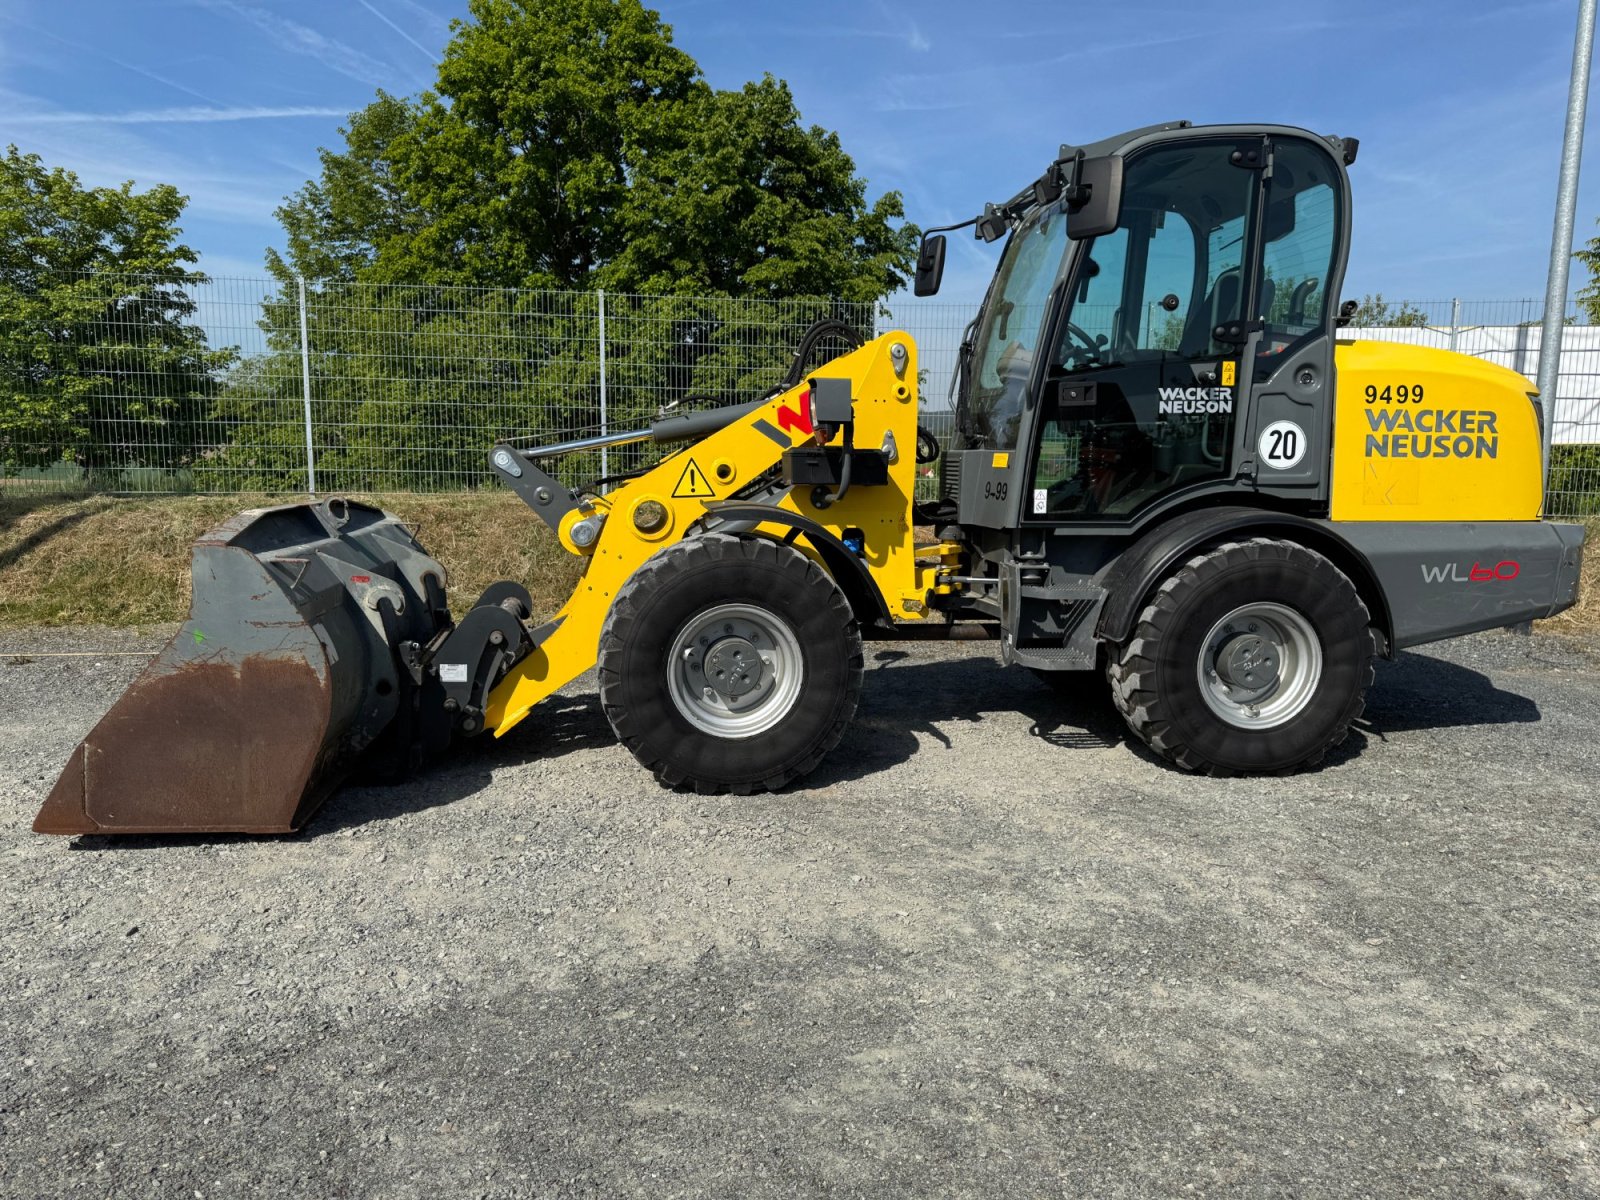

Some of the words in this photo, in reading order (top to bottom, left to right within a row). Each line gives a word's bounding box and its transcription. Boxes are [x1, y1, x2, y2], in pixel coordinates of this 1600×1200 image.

[1158, 387, 1232, 401] WACKER
[1365, 384, 1424, 404] 9499
[1159, 400, 1232, 414] NEUSON
[1364, 408, 1498, 434] WACKER
[1268, 429, 1297, 460] 20
[1364, 433, 1498, 459] NEUSON
